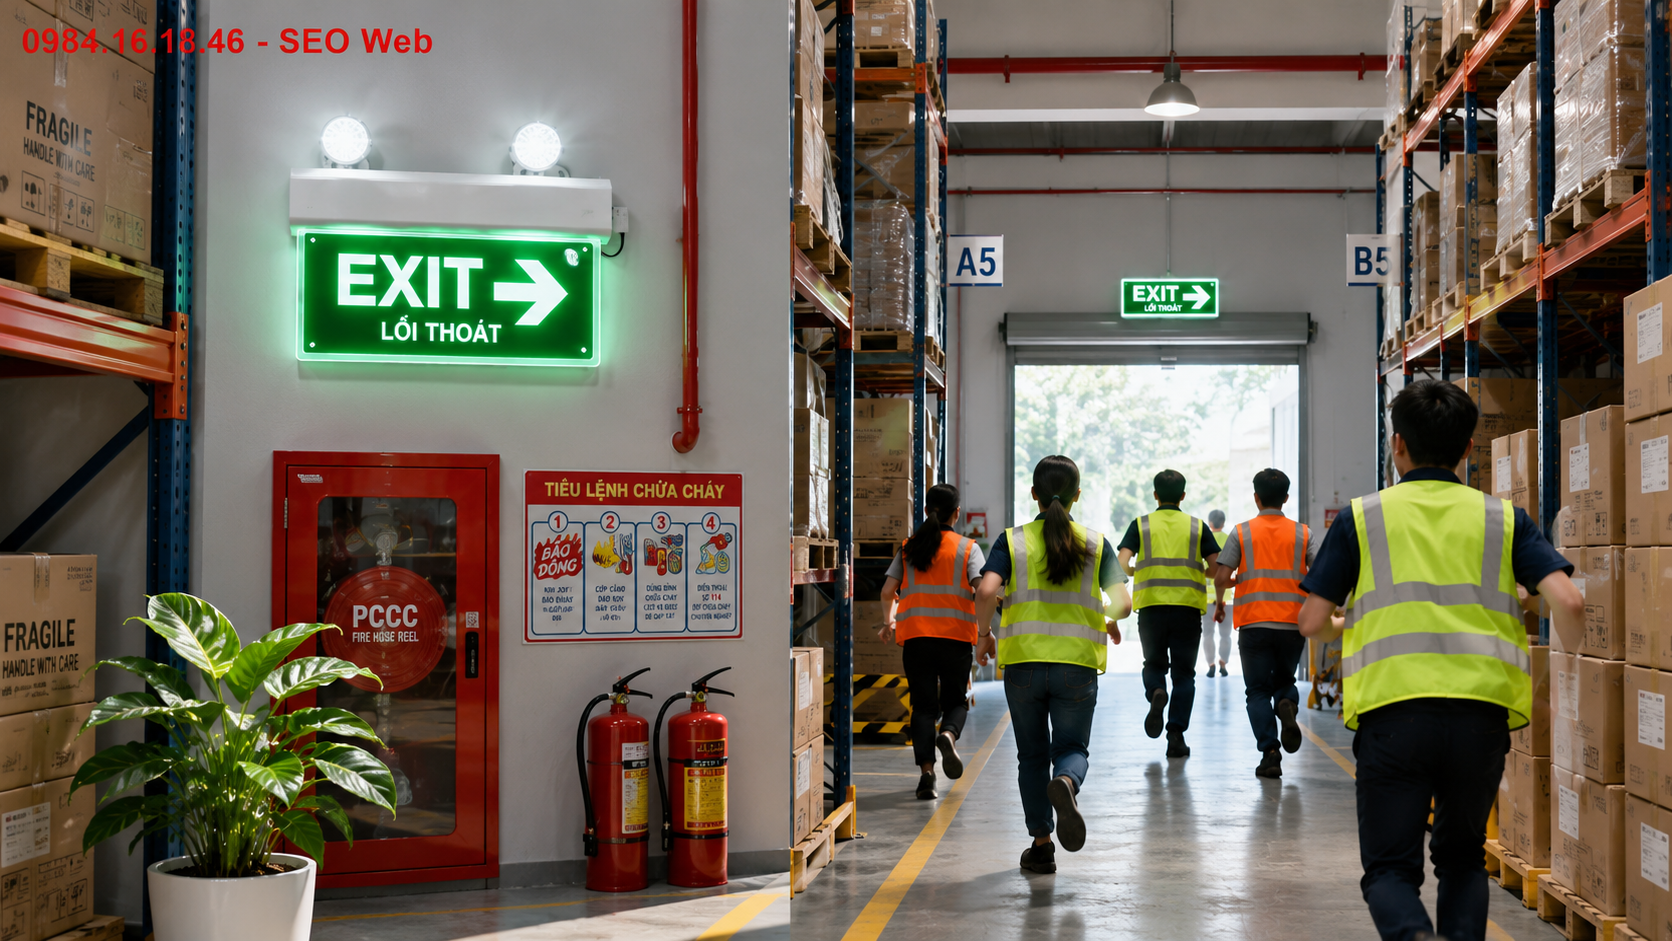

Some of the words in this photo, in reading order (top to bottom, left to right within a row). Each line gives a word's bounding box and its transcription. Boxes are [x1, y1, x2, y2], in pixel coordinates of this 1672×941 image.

[26, 100, 92, 157] FRAGILE
[23, 137, 54, 166] HANDLE
[75, 159, 96, 182] CARE
[955, 246, 996, 277] A5
[1355, 246, 1392, 277] B5
[337, 253, 484, 310] EXIT
[1132, 284, 1180, 302] EXIT
[424, 318, 502, 343] THOÁT
[544, 477, 581, 497] TIÊU
[682, 480, 725, 499] CHÁY
[553, 515, 561, 528] 1
[606, 515, 615, 529] 2
[657, 515, 666, 529] 3
[706, 516, 715, 530] 4
[353, 604, 418, 628] PCCC
[4, 618, 76, 653] FRAGILE
[352, 631, 371, 643] FIRE
[373, 630, 396, 643] HOSE
[397, 630, 419, 643] REEL
[2, 657, 36, 680] HANDLE
[36, 655, 57, 675] WITH
[58, 653, 80, 673] CARE
